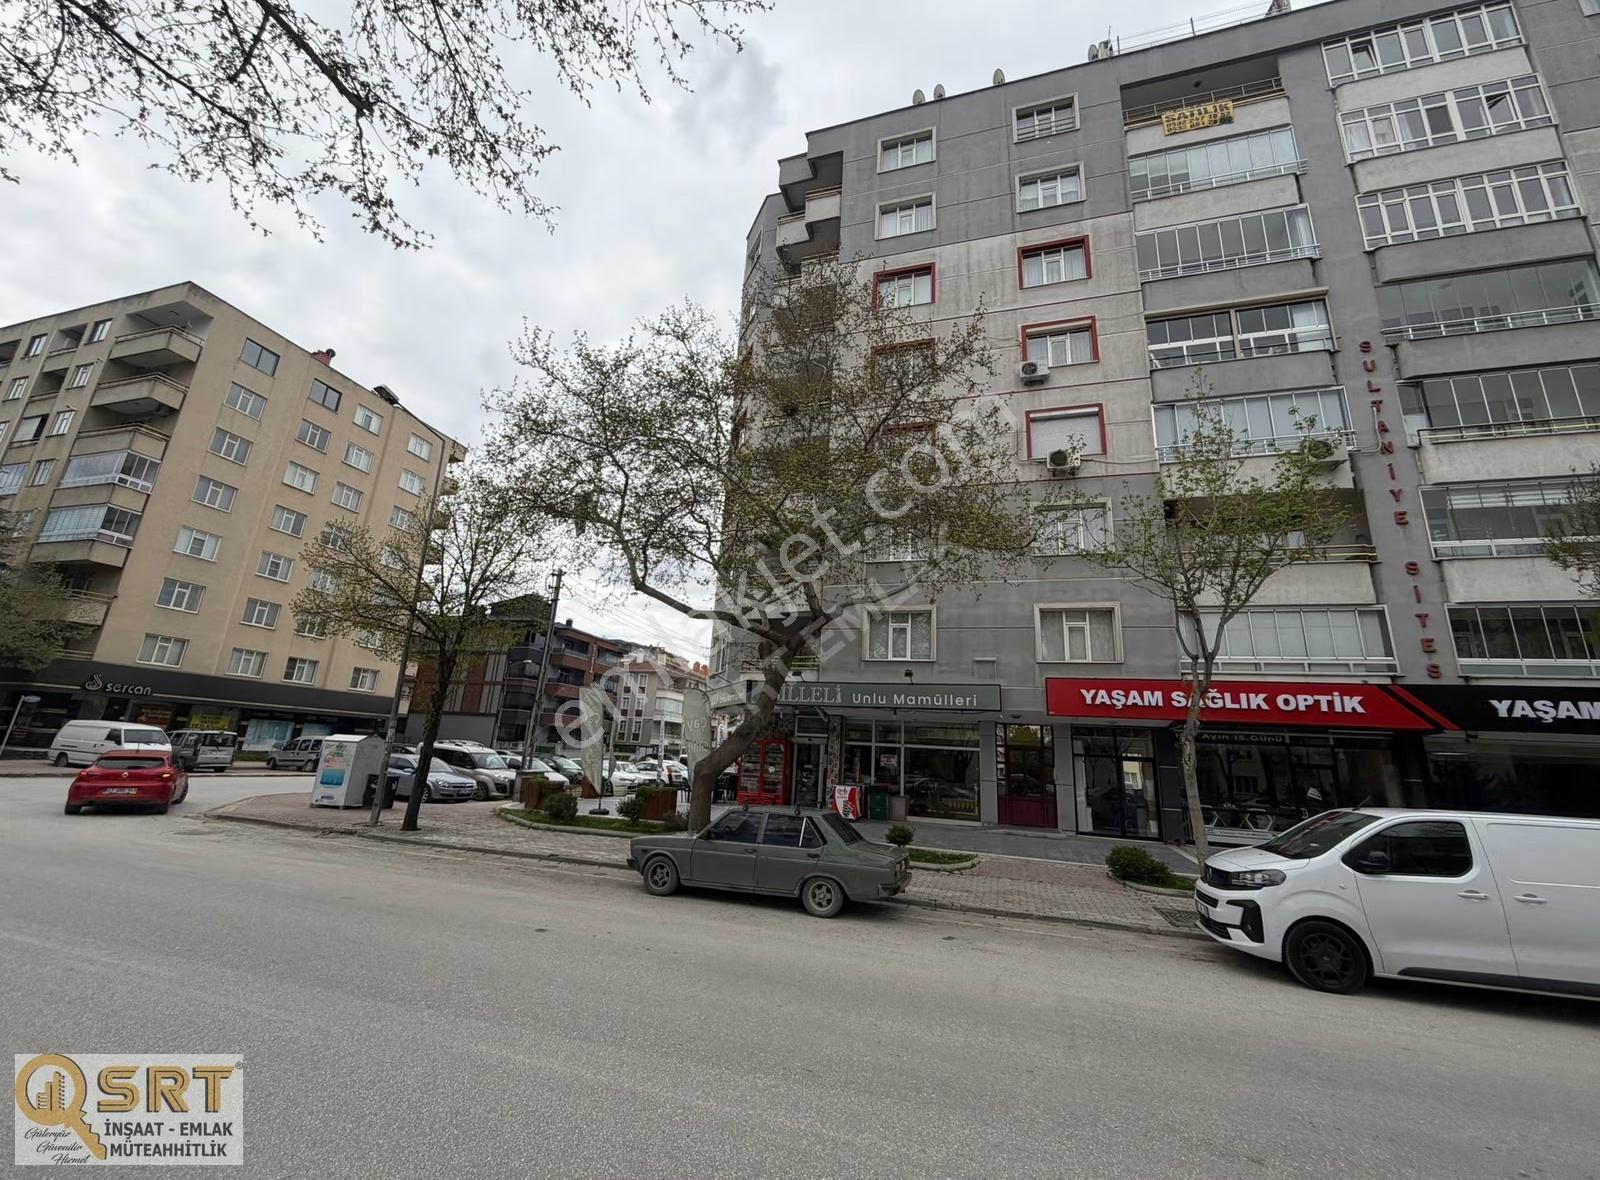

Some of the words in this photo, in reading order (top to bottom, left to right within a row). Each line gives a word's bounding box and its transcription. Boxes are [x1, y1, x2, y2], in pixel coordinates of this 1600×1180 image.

[105, 682, 152, 696] sercan
[852, 692, 886, 704] Unlu
[893, 694, 978, 706] Mamülleri
[1080, 688, 1164, 709] YAŞAM
[1275, 691, 1367, 714] OPTİK
